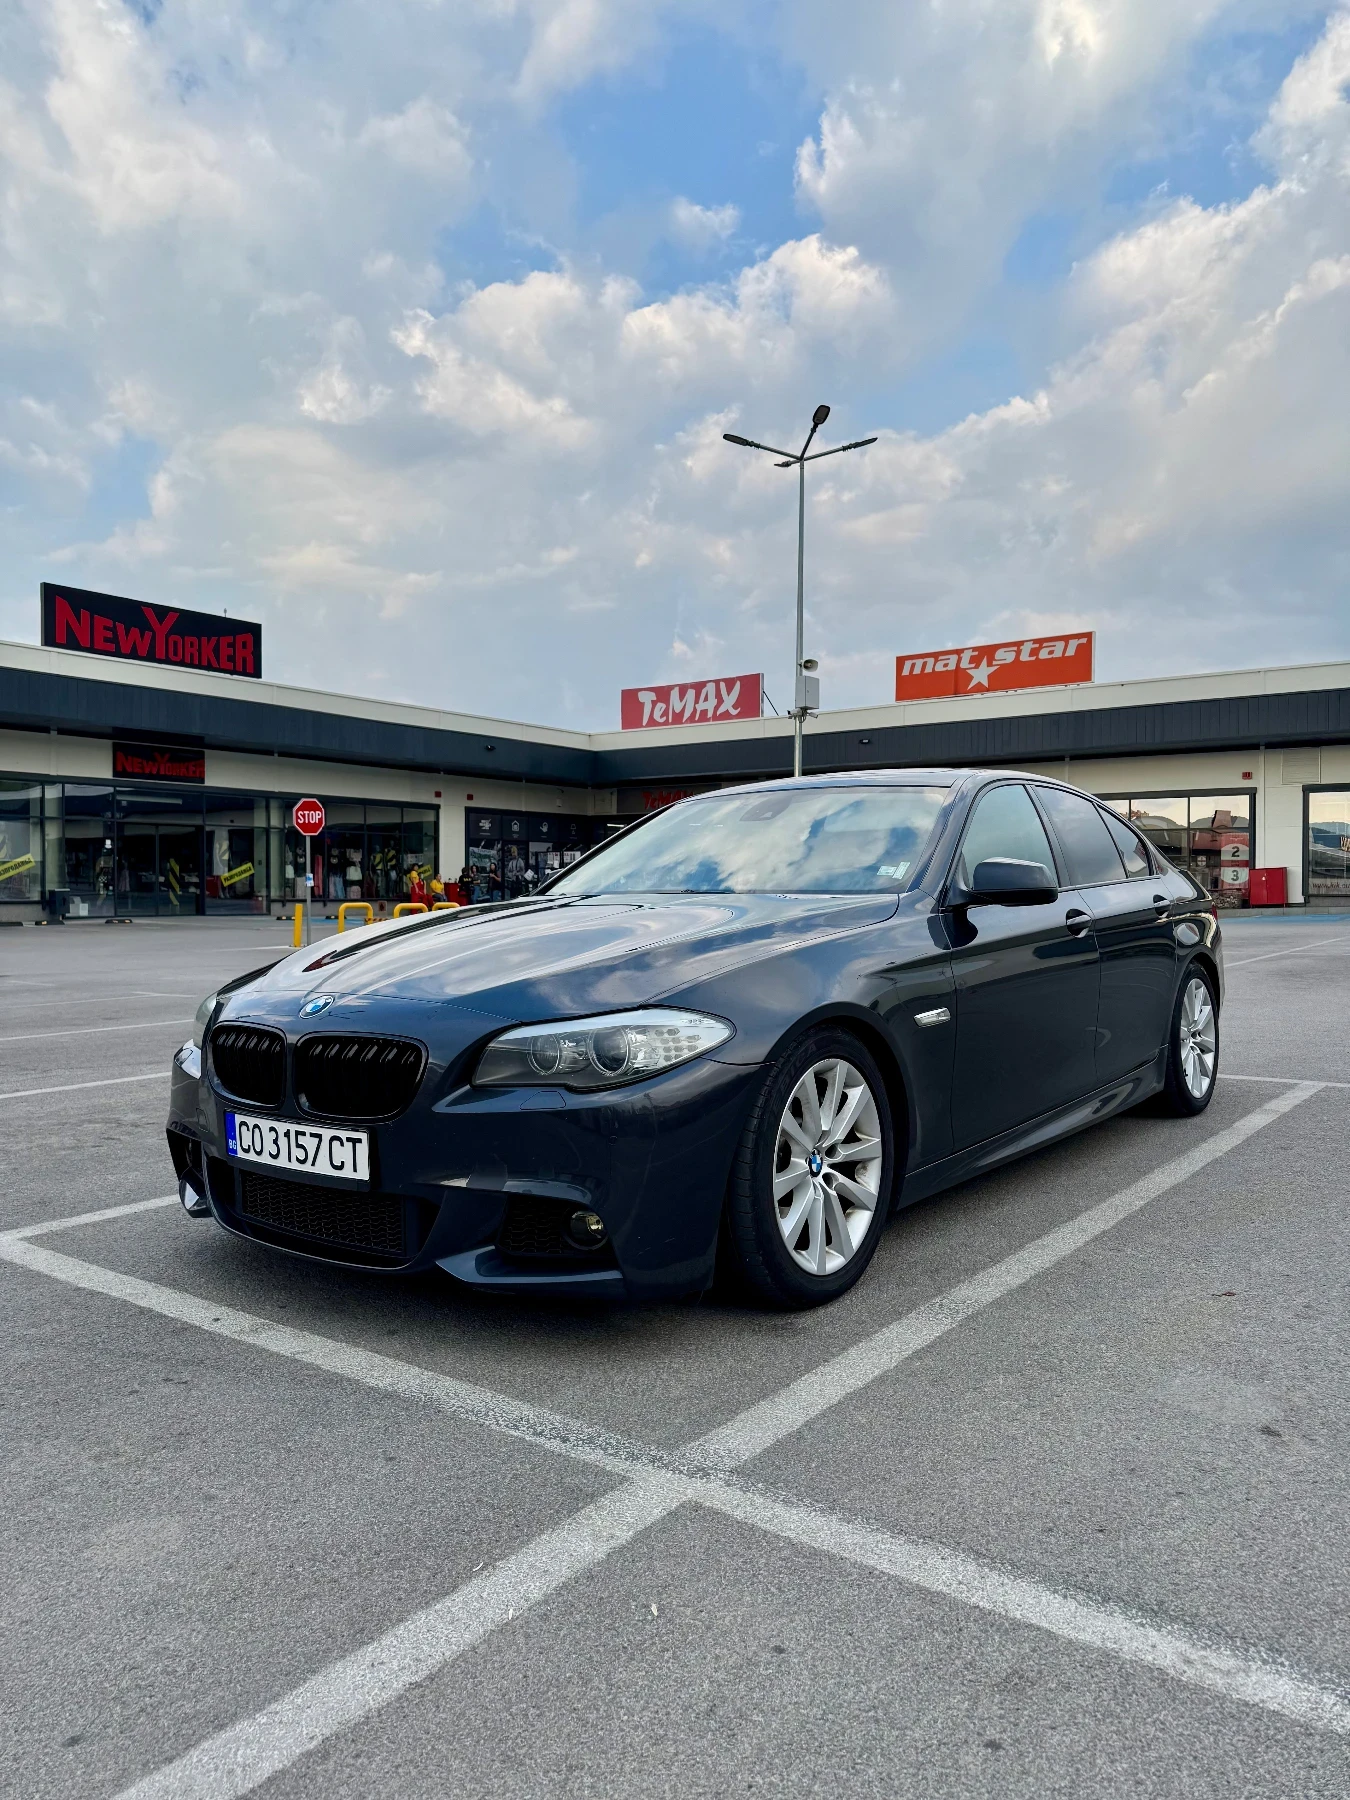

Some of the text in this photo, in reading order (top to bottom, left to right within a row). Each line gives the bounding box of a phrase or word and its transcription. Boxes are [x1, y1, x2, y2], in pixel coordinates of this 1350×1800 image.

[901, 637, 1088, 677] mat star
[297, 810, 322, 824] STOP
[1231, 846, 1240, 858] 2
[1231, 869, 1240, 882] 3
[268, 1125, 323, 1167] 3157
[328, 1134, 363, 1173] CT
